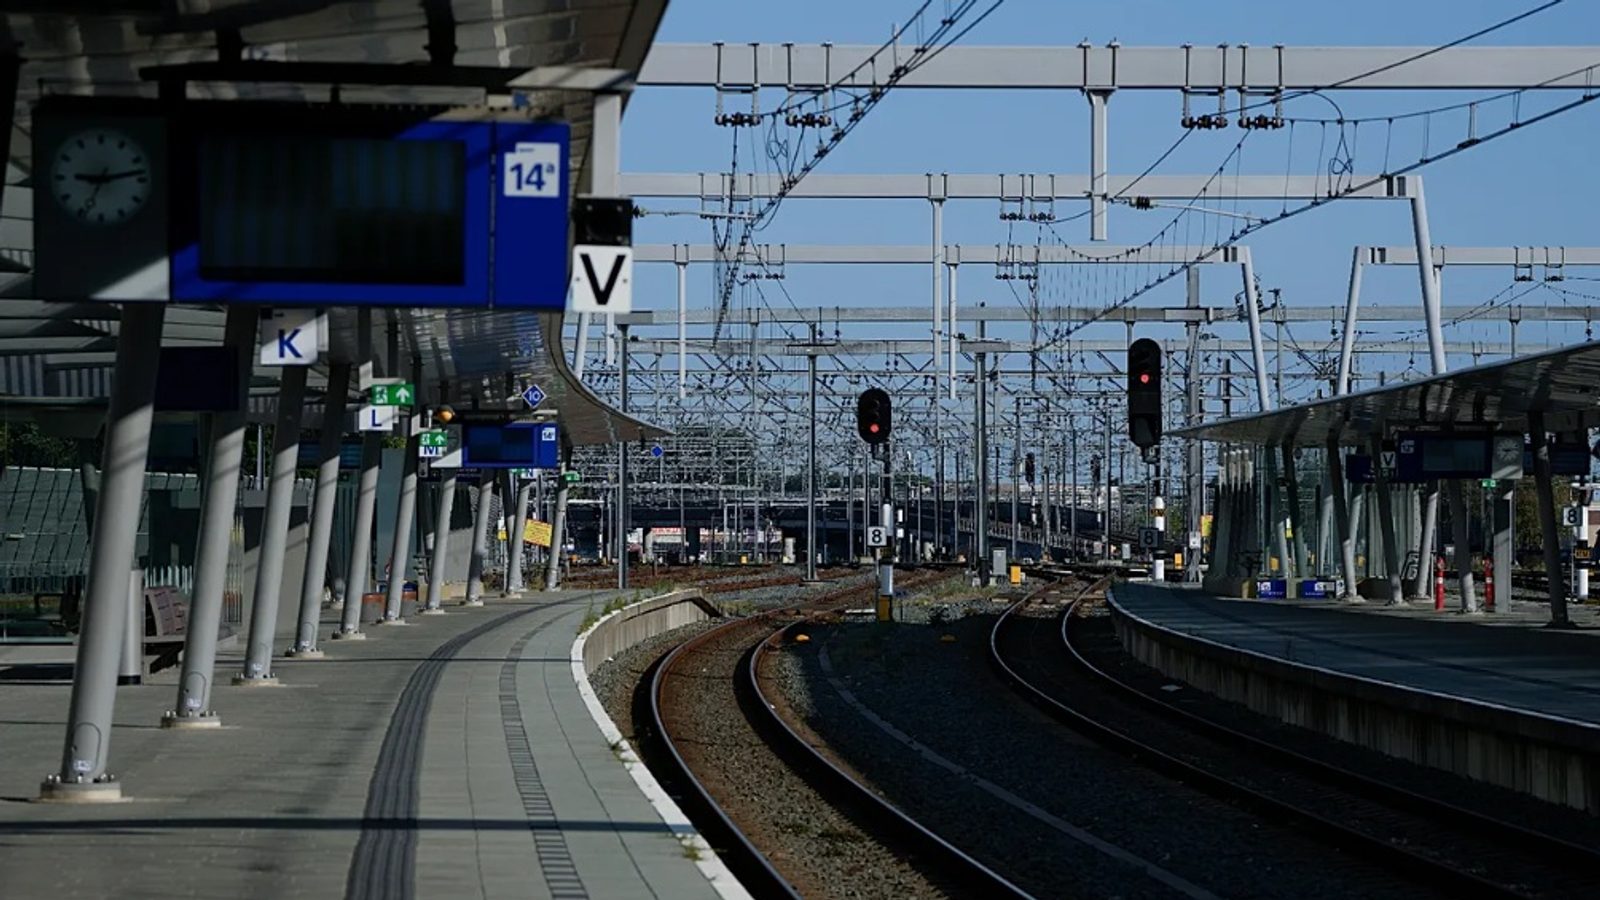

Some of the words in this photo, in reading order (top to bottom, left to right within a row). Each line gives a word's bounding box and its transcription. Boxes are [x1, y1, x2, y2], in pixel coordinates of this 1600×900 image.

[580, 253, 626, 305] V
[278, 328, 303, 358] K
[371, 409, 382, 427] L
[423, 445, 438, 455] M
[1383, 453, 1394, 466] V
[1568, 508, 1577, 523] 8
[871, 529, 882, 544] 8
[1144, 531, 1154, 544] 8
